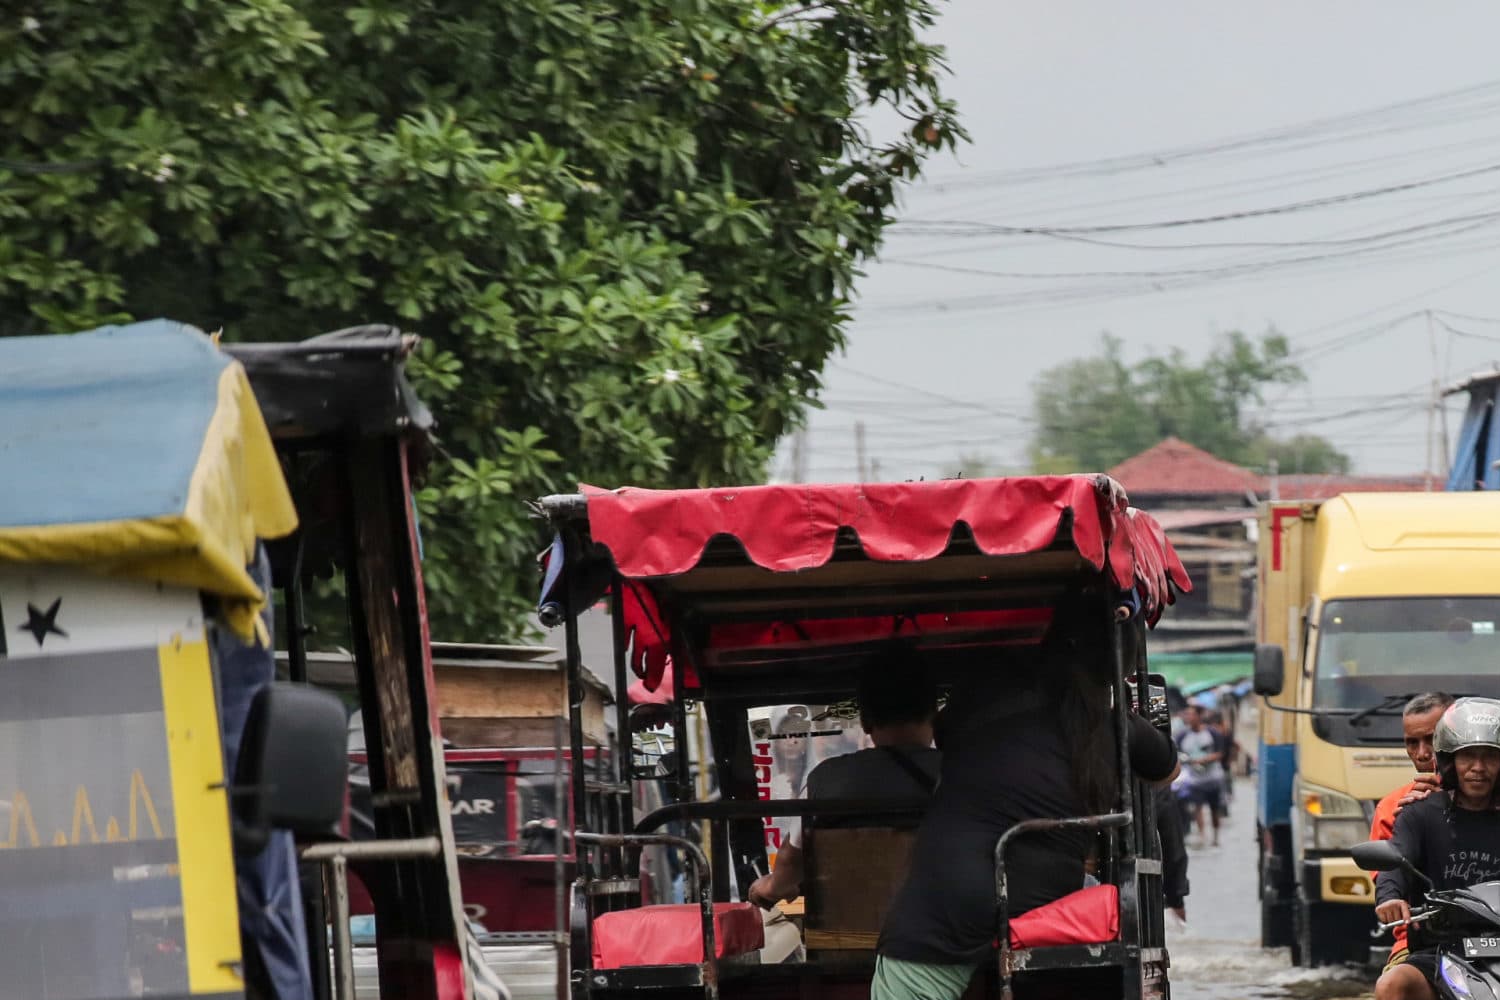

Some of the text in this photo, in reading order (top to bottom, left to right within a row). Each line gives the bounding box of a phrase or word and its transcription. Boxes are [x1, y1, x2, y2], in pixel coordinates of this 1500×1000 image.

[450, 798, 495, 815] AR
[1449, 851, 1500, 865] TOMMY
[1466, 938, 1474, 948] A
